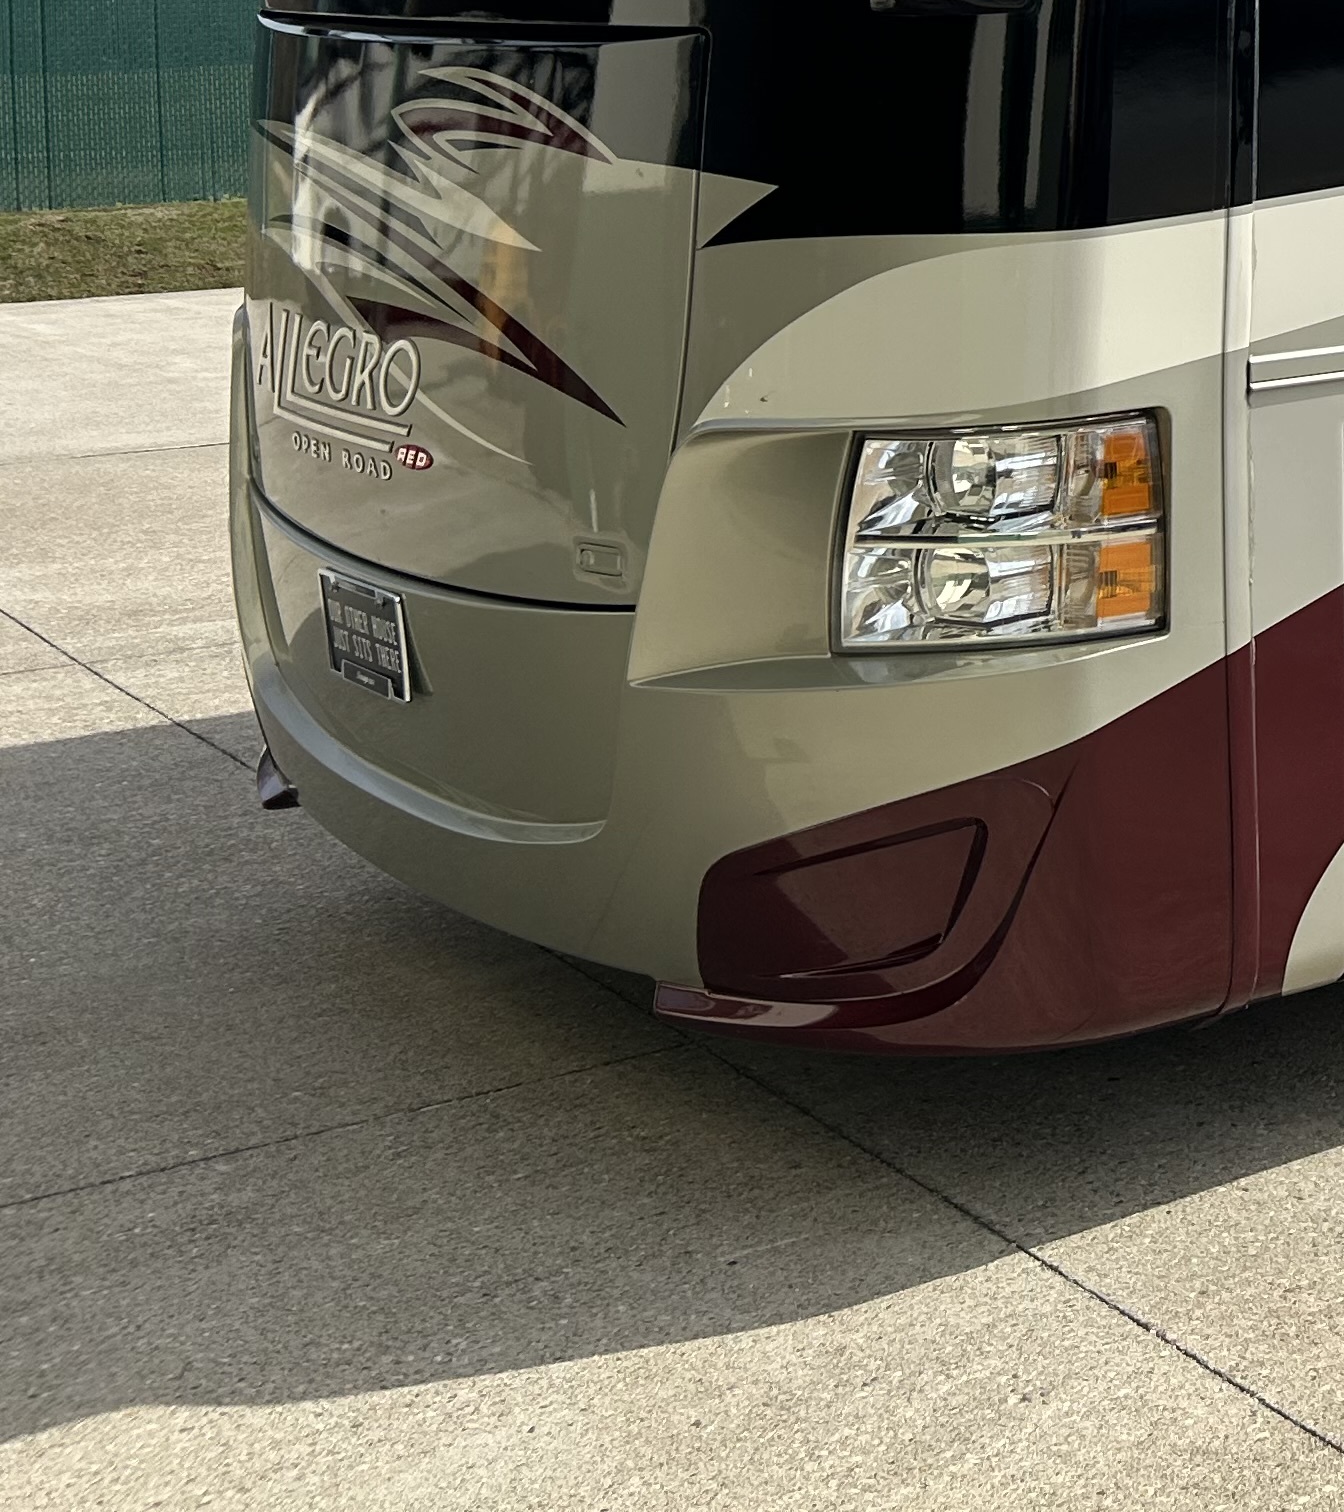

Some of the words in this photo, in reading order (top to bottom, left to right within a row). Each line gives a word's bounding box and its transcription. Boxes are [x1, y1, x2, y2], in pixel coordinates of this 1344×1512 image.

[257, 302, 421, 450] ALLEGRO
[292, 431, 332, 463] OPEN
[341, 448, 393, 481] ROAD
[396, 446, 429, 468] RED
[344, 605, 370, 635] OTHER
[371, 615, 397, 646] HOUSE
[352, 634, 373, 662] SITS
[375, 643, 401, 673] THERE
